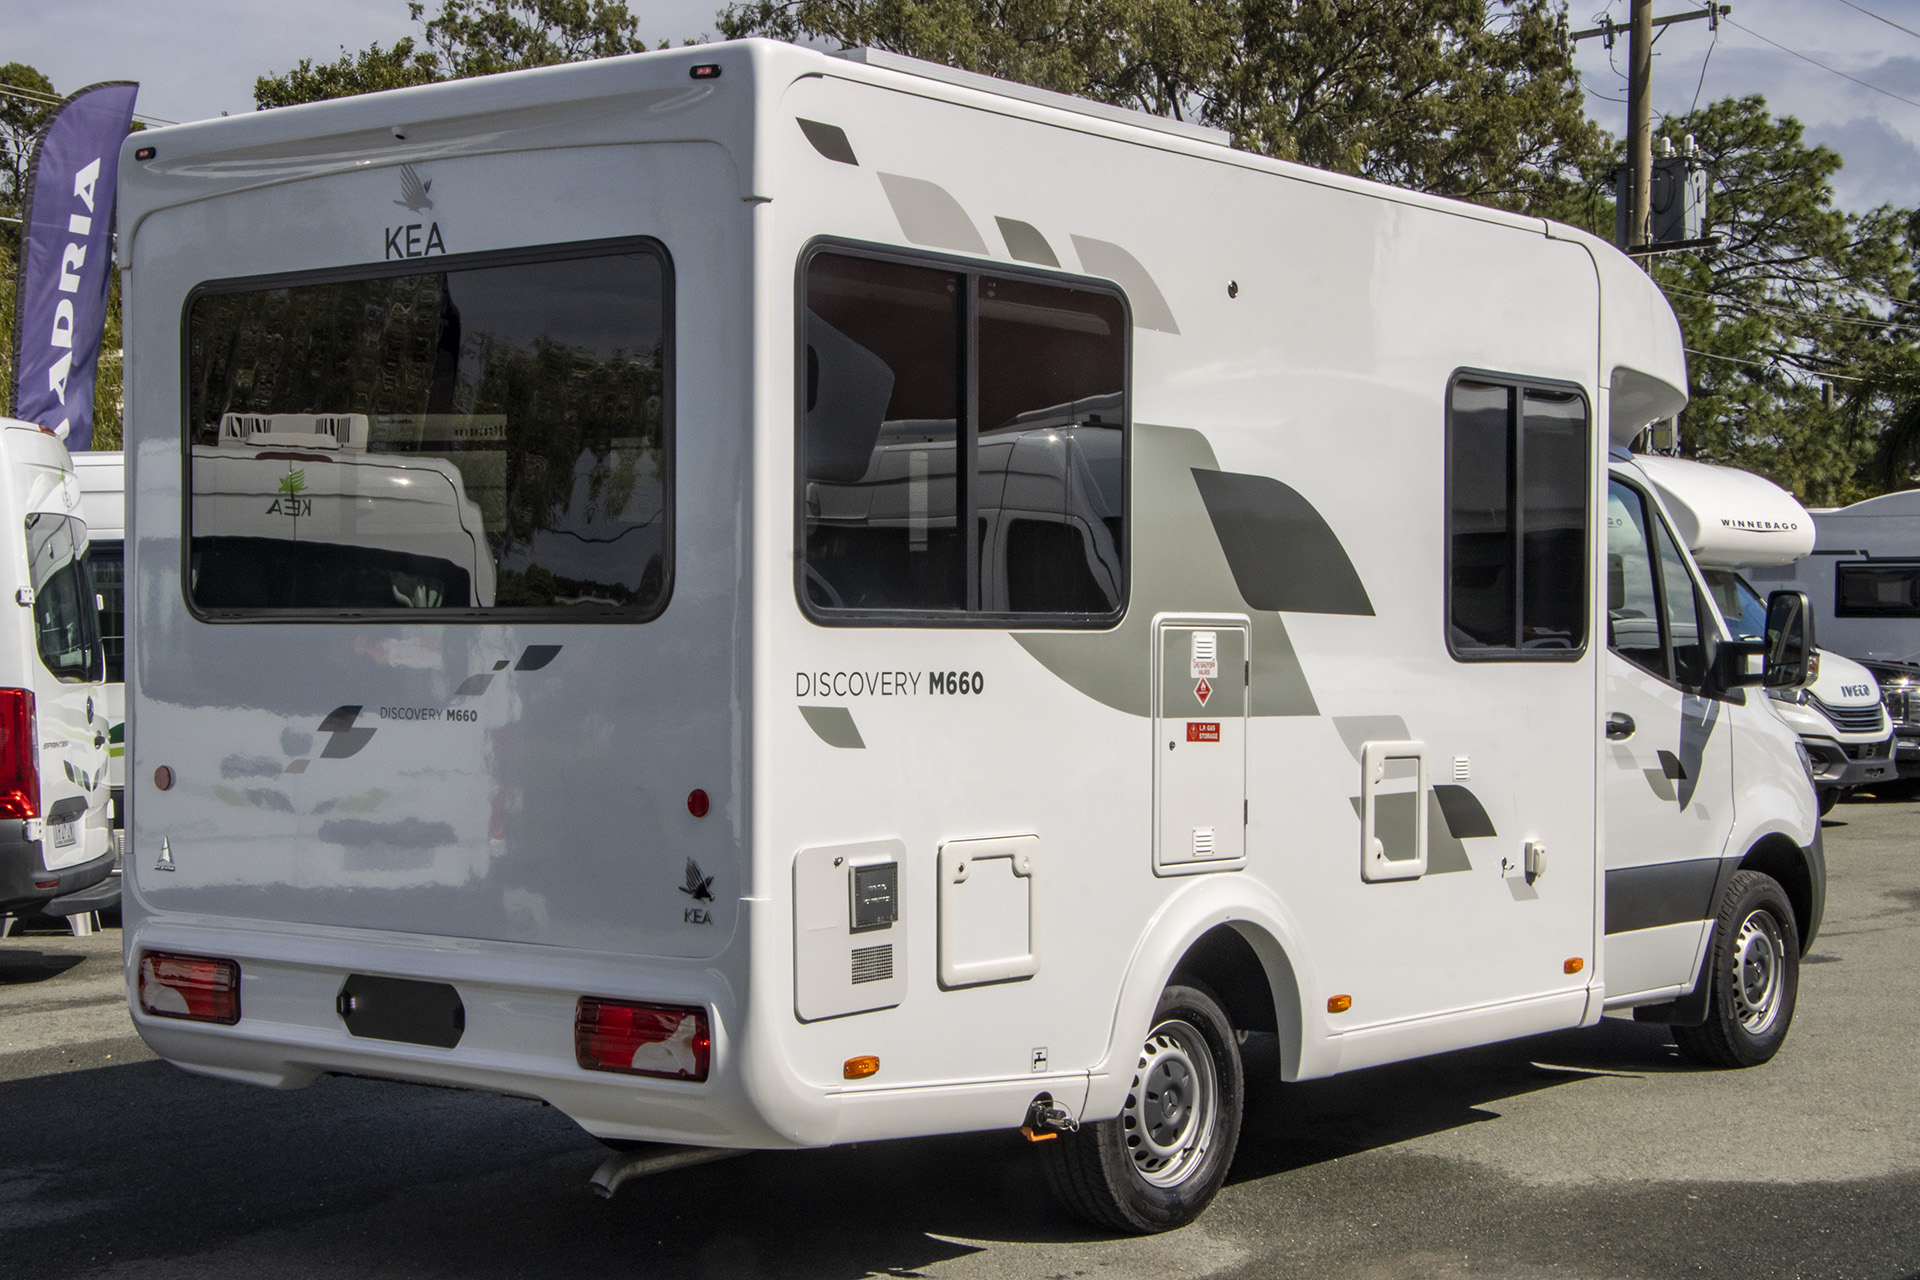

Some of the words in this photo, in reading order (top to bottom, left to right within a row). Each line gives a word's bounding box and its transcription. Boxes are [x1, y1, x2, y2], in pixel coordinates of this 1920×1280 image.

[385, 221, 446, 260] KEA
[49, 157, 101, 406] ADRIA
[1721, 518, 1798, 531] WINNEBAGO
[795, 671, 922, 697] DISCOVERY
[929, 671, 984, 695] M660
[1840, 684, 1871, 698] IVECO
[380, 706, 443, 720] DISCOVERY
[446, 709, 478, 722] M660
[684, 908, 713, 925] KEA
